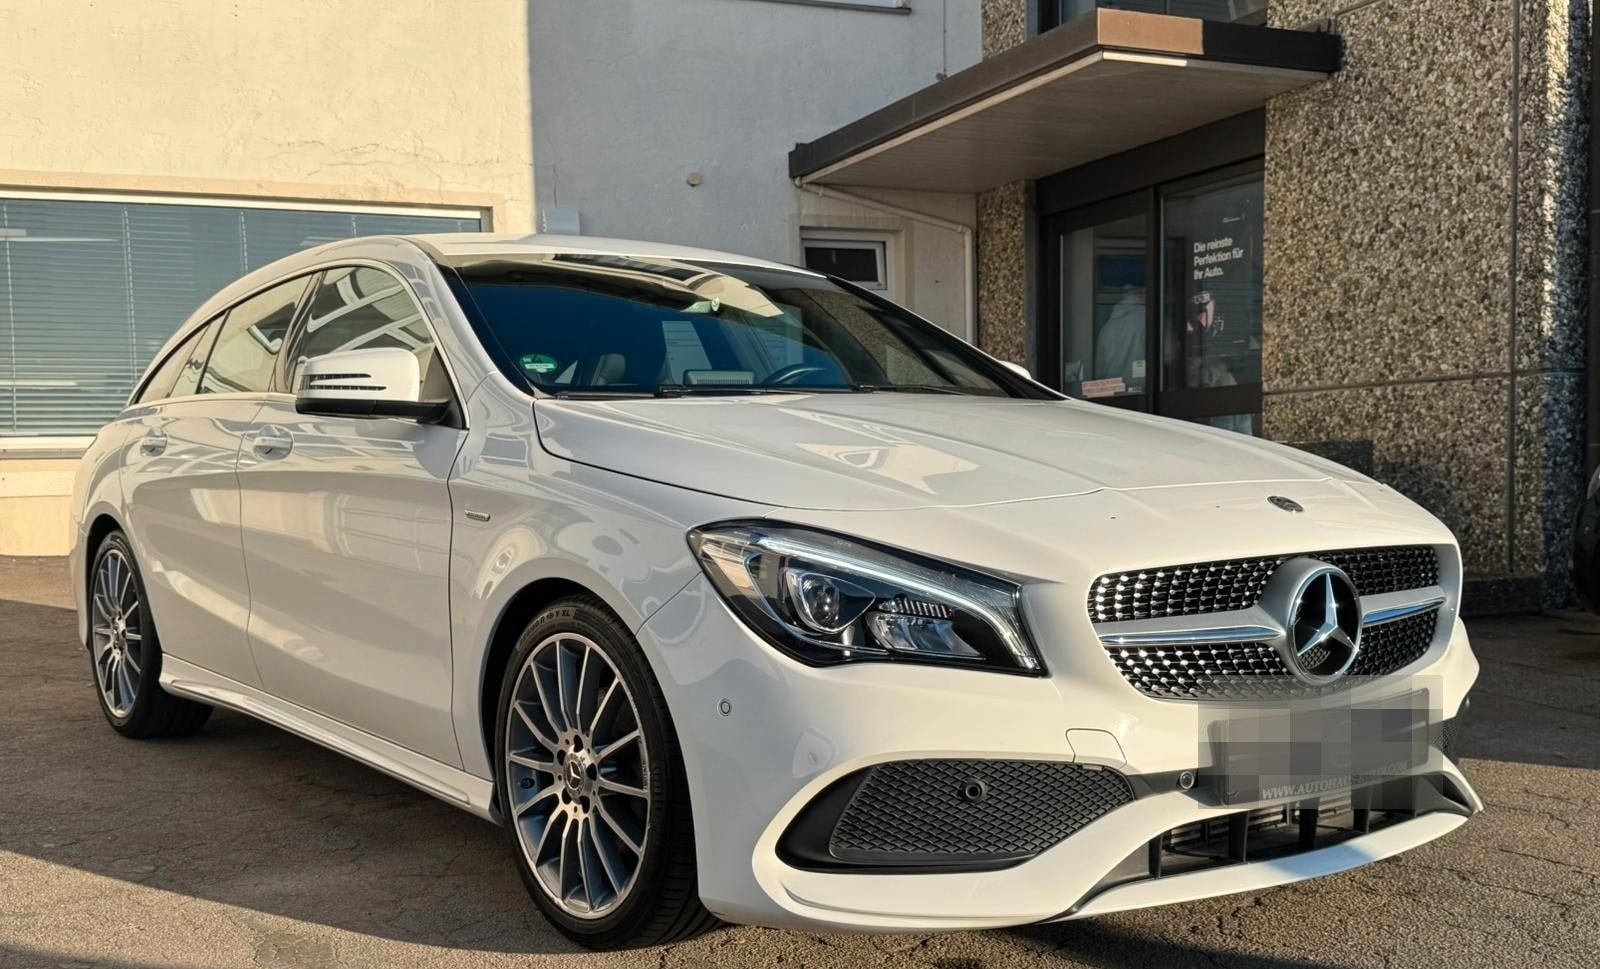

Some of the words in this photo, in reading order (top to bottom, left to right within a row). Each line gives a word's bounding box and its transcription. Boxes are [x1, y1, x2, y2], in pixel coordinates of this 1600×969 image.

[1193, 242, 1205, 253] Die
[1206, 237, 1232, 250] reinste
[1193, 252, 1231, 267] Perfektion
[1232, 247, 1244, 259] für
